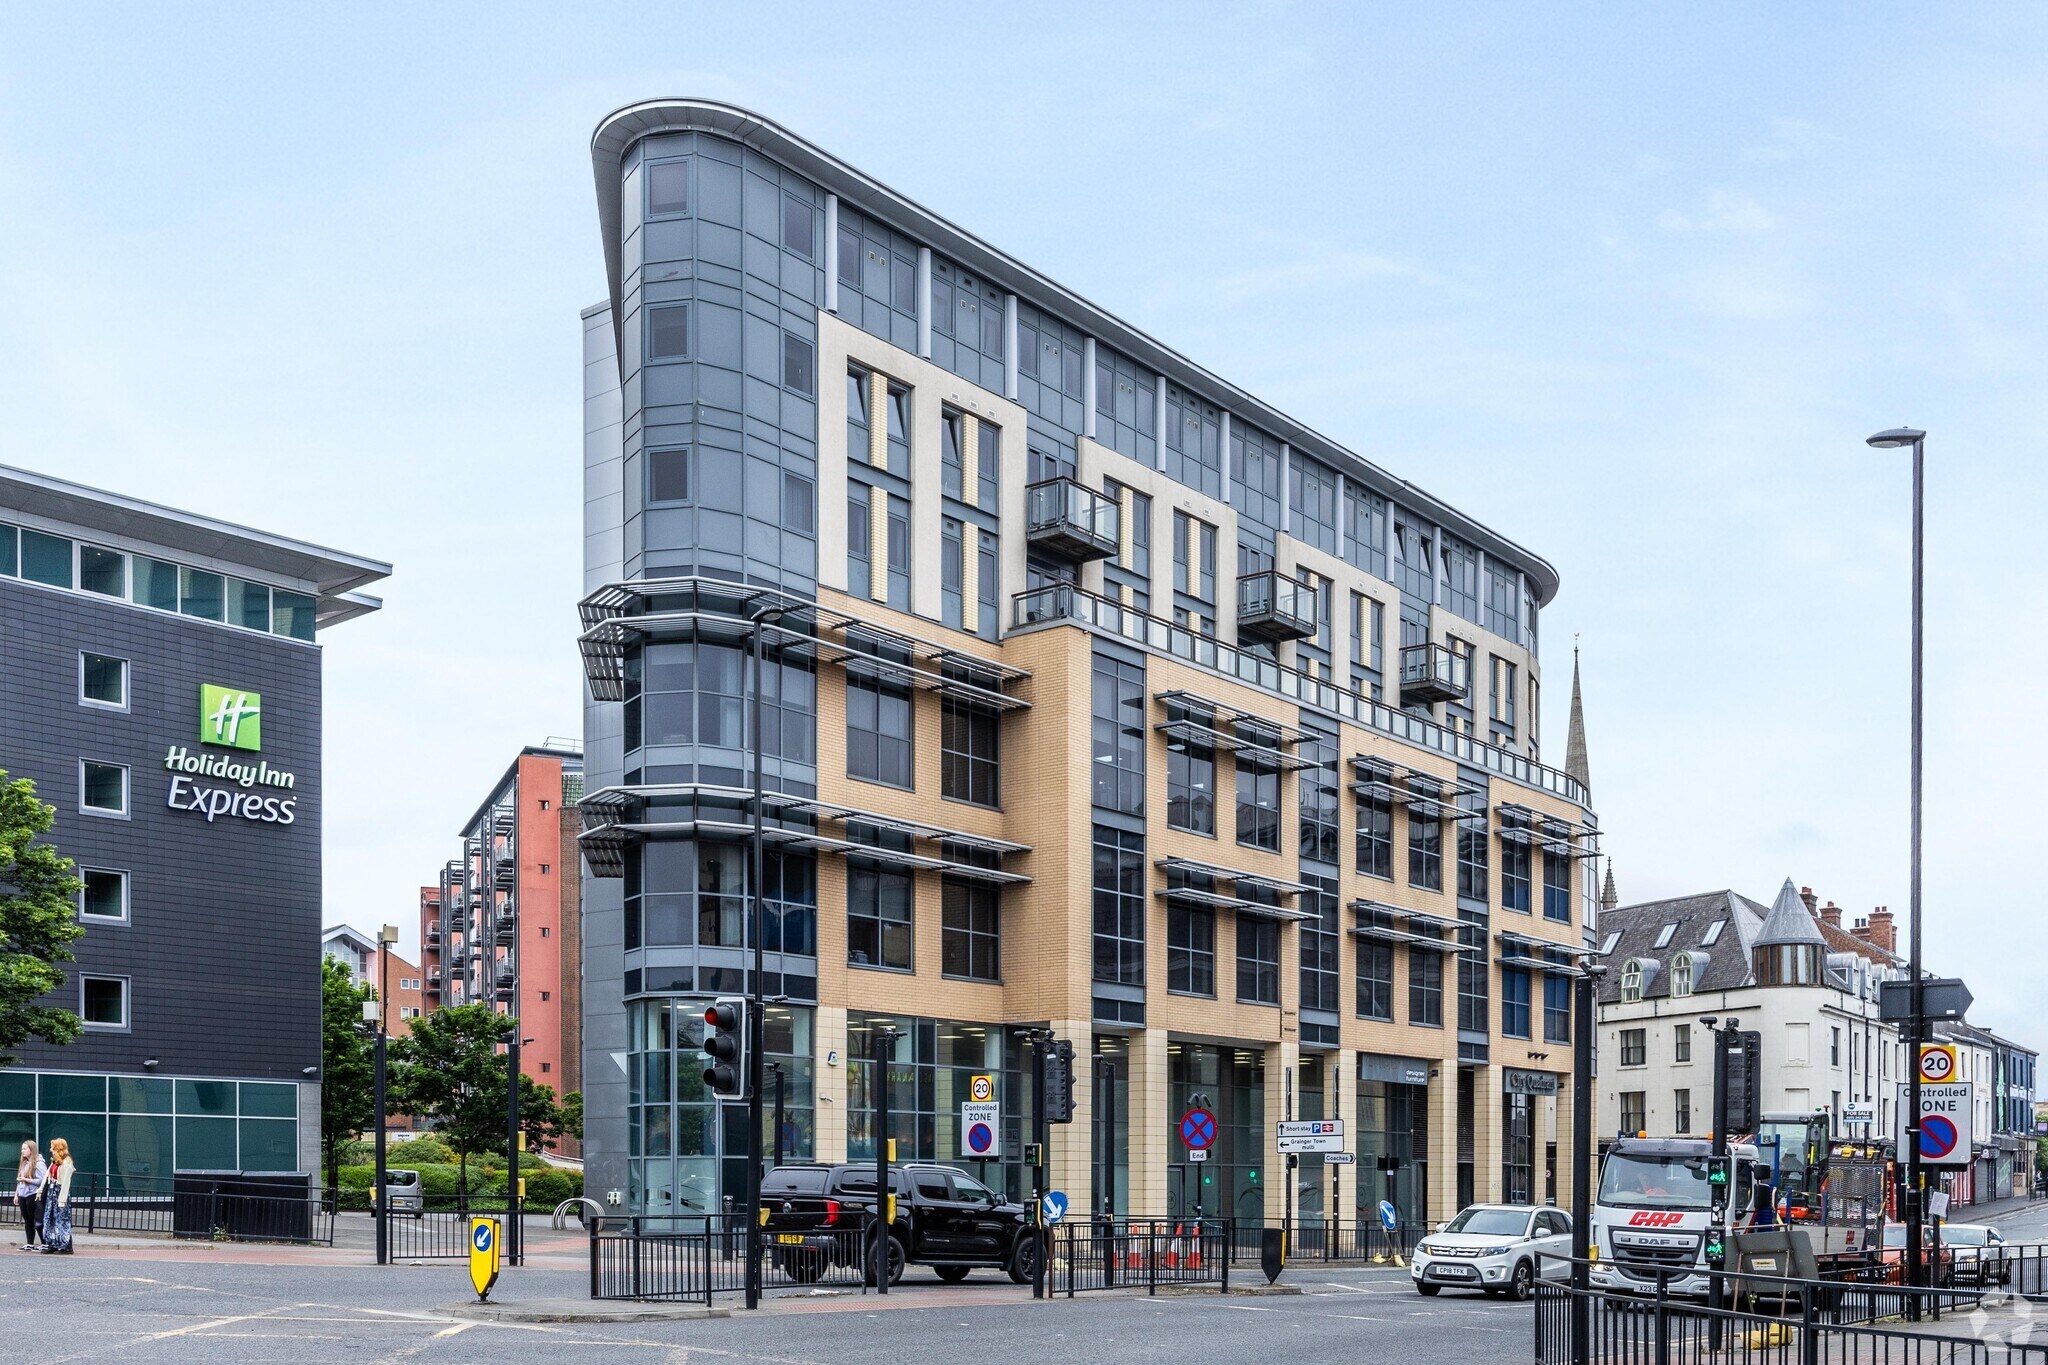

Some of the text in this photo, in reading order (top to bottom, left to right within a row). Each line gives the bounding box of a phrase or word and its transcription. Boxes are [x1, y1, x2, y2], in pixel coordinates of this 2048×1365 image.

[164, 745, 295, 789] Holiday Inn
[168, 775, 297, 824] Express
[1924, 1056, 1949, 1071] 20
[1405, 1069, 1425, 1077] designer
[975, 1083, 988, 1093] 20
[1510, 1072, 1524, 1091] City
[1903, 1087, 1967, 1098] Cntrolled
[1921, 1100, 1957, 1112] ONE
[968, 1113, 992, 1121] ZONE
[1628, 1211, 1685, 1228] GAP
